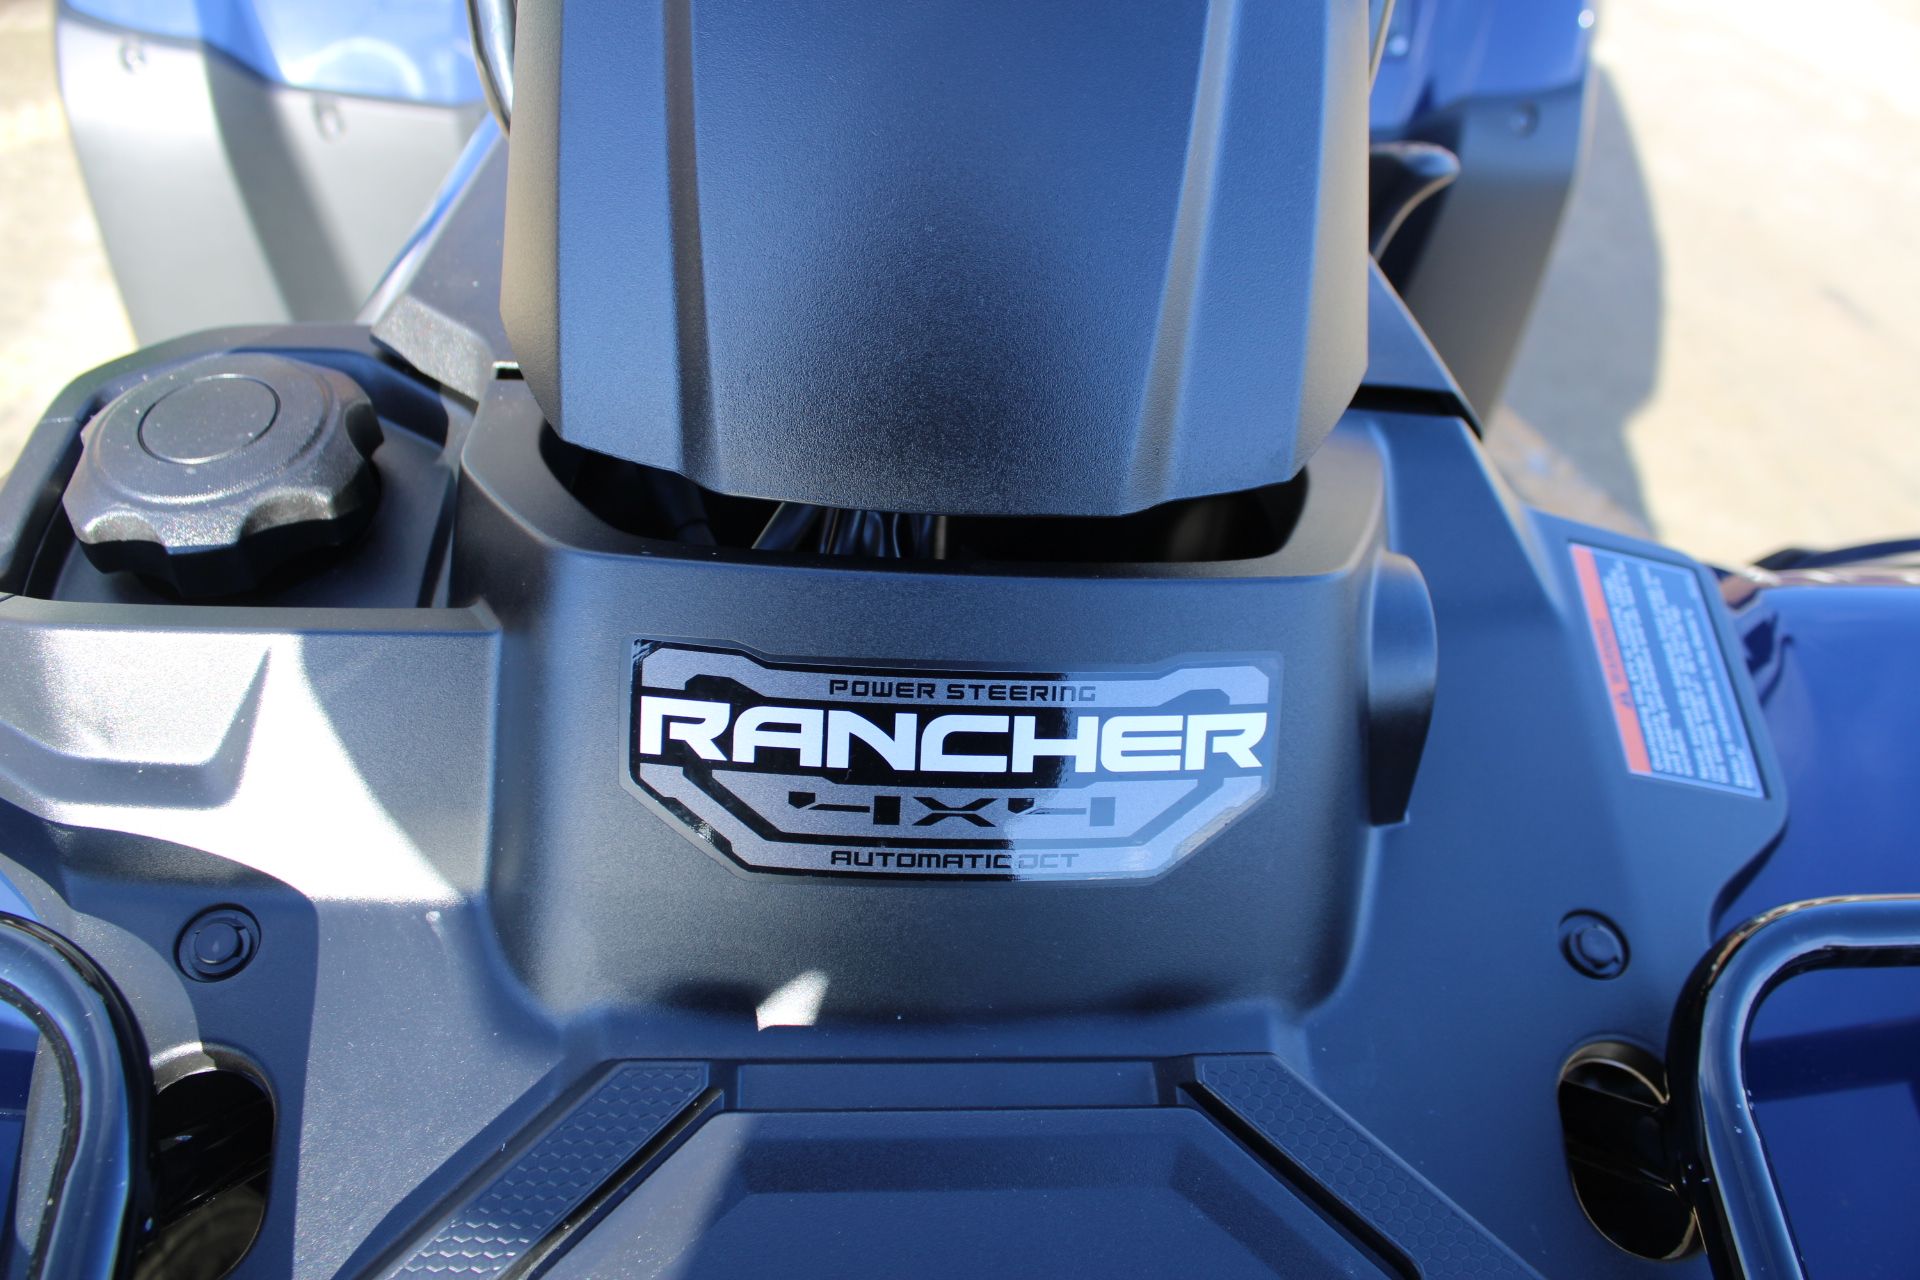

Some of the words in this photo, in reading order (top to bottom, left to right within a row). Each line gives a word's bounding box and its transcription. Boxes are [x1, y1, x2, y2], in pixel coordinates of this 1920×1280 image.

[829, 679, 936, 700] POWER
[946, 683, 1097, 702] STEERING
[639, 695, 1268, 773] RANCHER
[830, 850, 1012, 869] AUTOMATIC
[1018, 853, 1080, 869] DCT
